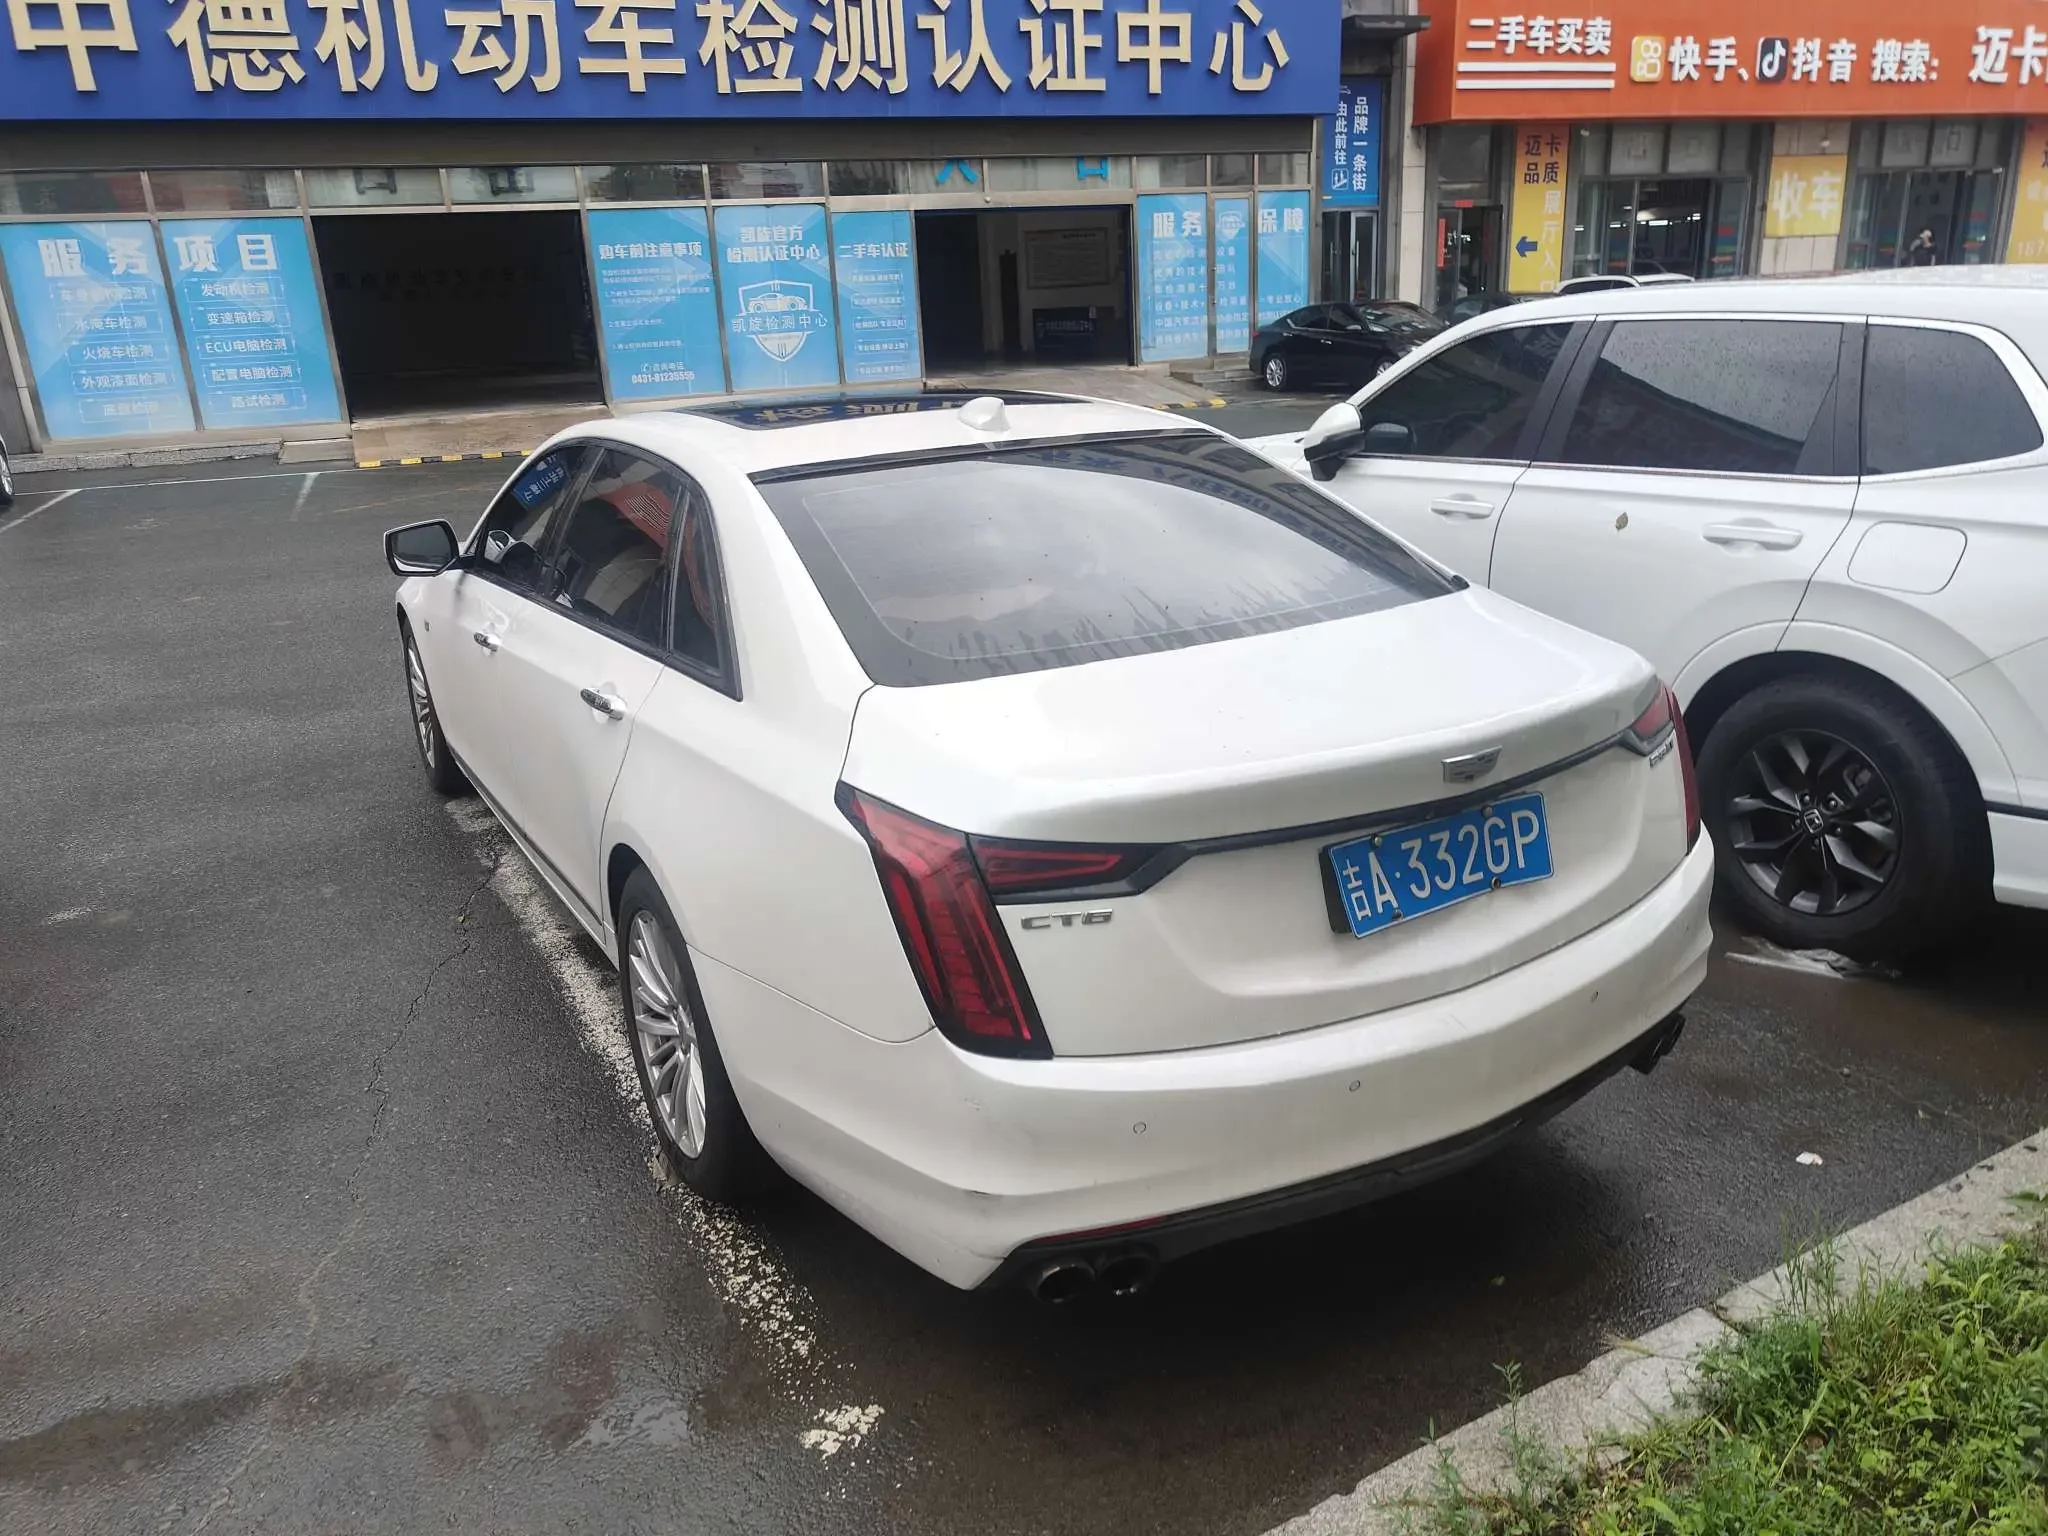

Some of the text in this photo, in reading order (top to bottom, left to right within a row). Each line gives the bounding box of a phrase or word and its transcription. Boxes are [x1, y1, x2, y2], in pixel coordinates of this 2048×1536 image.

[1466, 15, 1612, 55] 二手车买卖
[7, 0, 1290, 94] 中德机动车检测认证中心
[1792, 37, 1857, 82] 抖音
[1968, 25, 2048, 84] 迈卡
[1352, 96, 1369, 191] 品牌一条街
[1524, 133, 1562, 157] 迈卡
[1523, 162, 1560, 185] 品质
[1772, 170, 1841, 221] 收车
[1153, 207, 1305, 238] 服务 保障
[727, 243, 821, 263] 检测认证中心
[838, 242, 909, 259] 二手车认证
[201, 281, 270, 297] 发动机检测
[207, 310, 275, 326] 变速箱检测
[732, 312, 828, 333] 凯旋检测中心
[83, 344, 154, 361] 火烧车检测
[205, 337, 288, 354] ECU电脑检测
[82, 372, 168, 389] 外观漆面检测
[211, 364, 293, 382] 配置电脑检测
[1020, 908, 1113, 930] CT6
